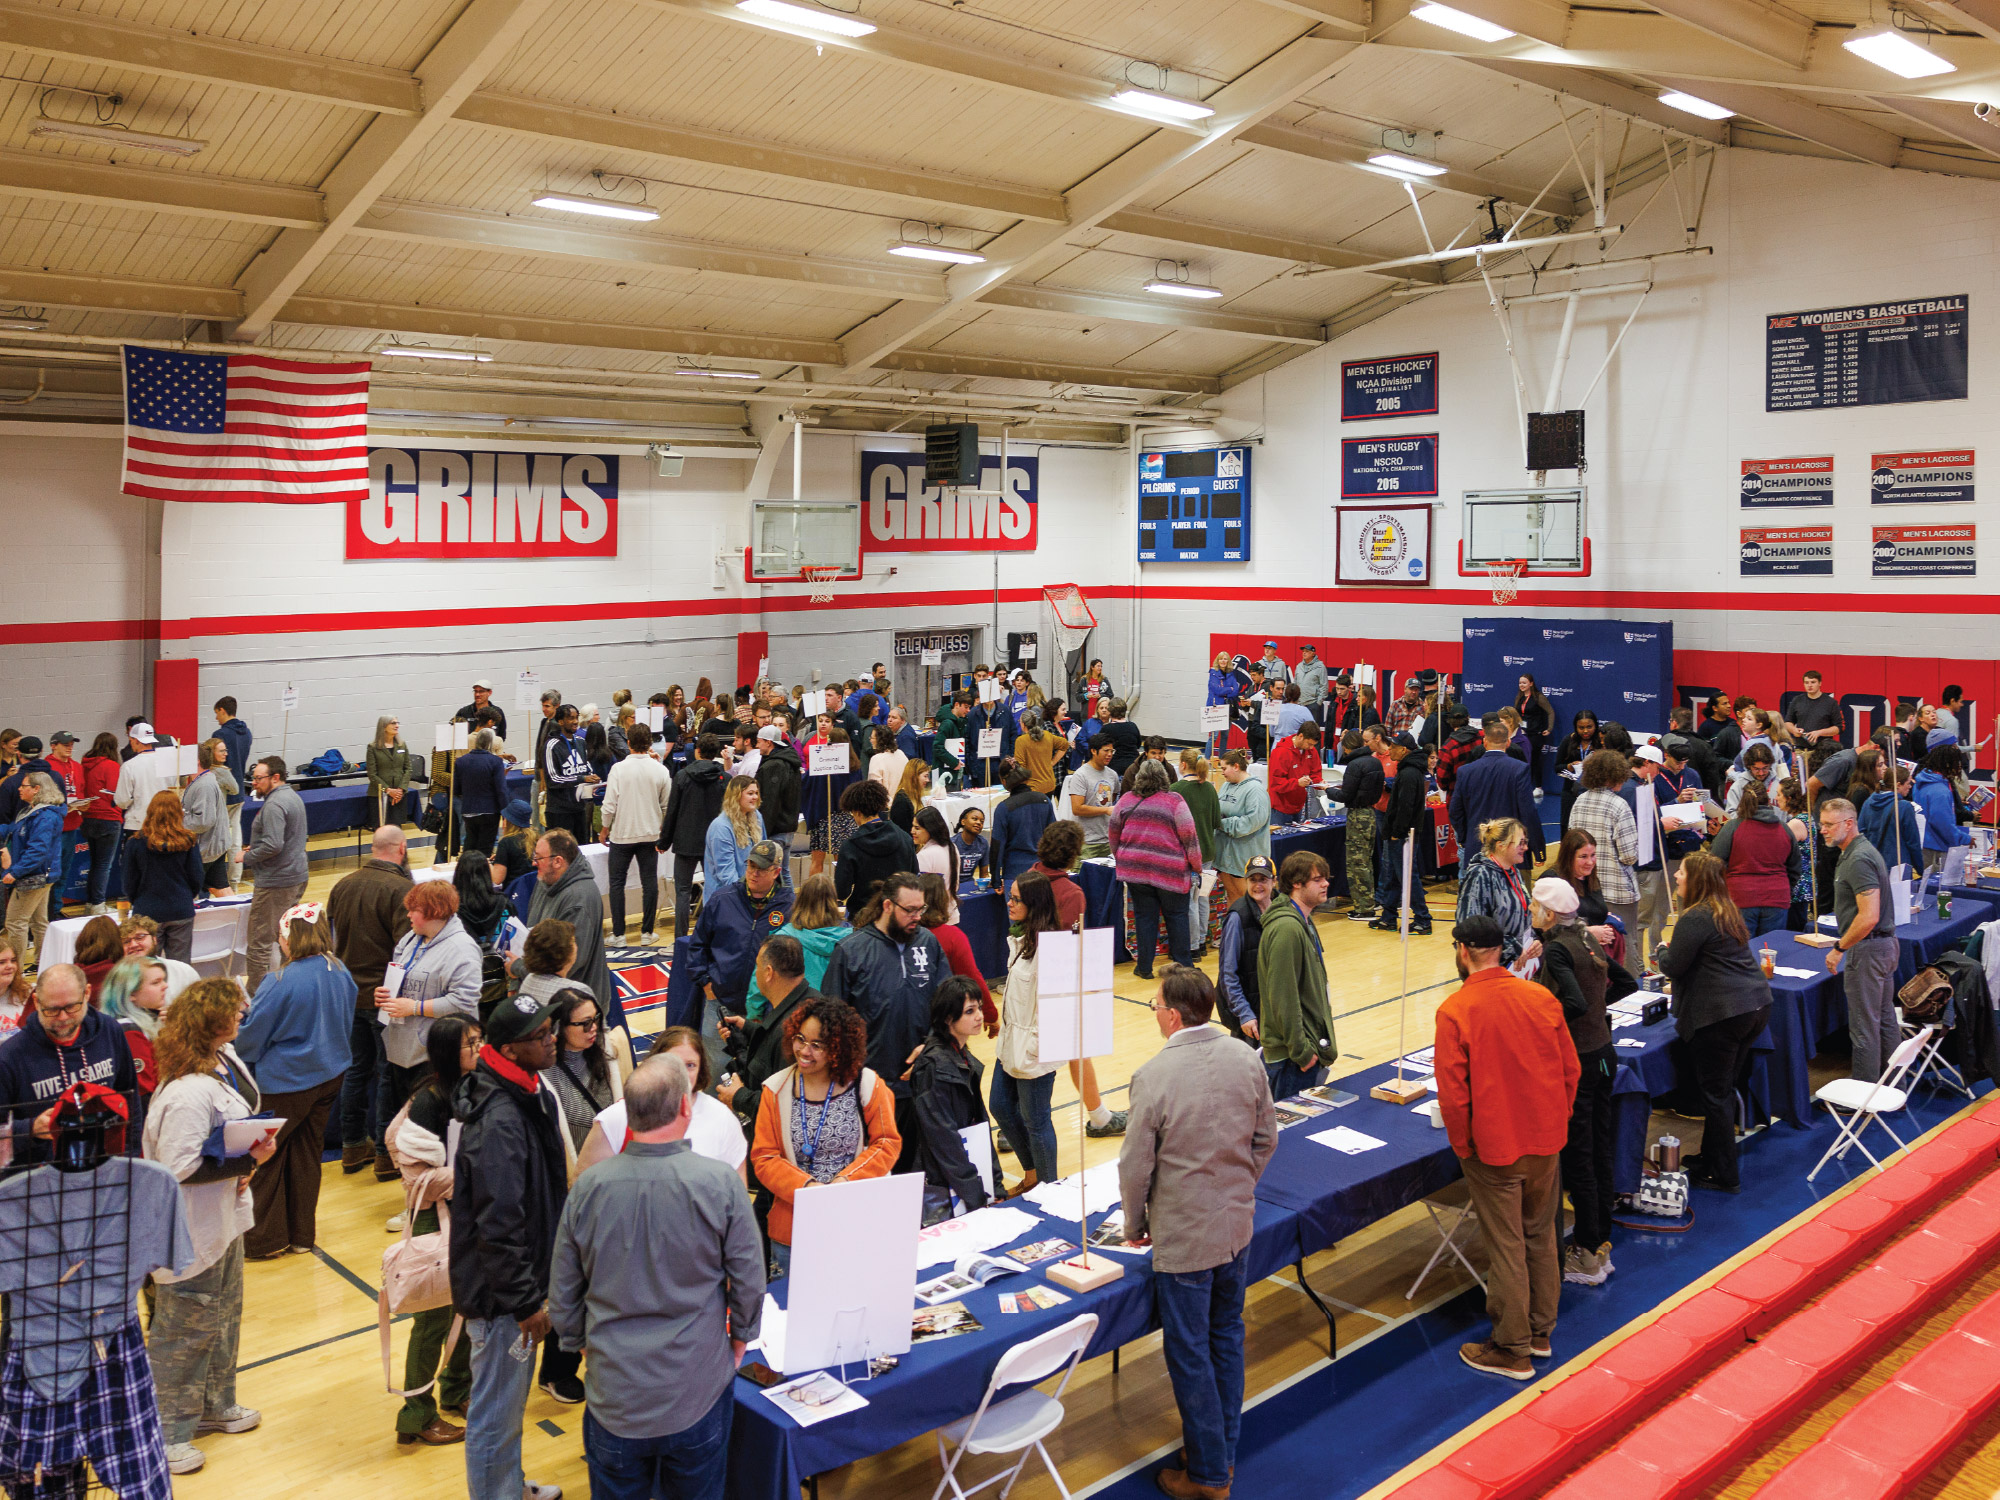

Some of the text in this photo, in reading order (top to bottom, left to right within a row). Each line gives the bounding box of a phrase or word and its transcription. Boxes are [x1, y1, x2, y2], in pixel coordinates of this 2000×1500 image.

[1801, 309, 1865, 325] WOMEN'S
[1869, 299, 1964, 318] BASKETBALL
[1824, 318, 1902, 331] 1,000 POINT SCORERS
[1347, 360, 1432, 377] MEN'S ICE HOCKEY
[1356, 374, 1422, 389] NCAA Division III
[1365, 384, 1412, 394] SEMIFINALIST
[1376, 397, 1401, 411] 2005
[1358, 441, 1420, 454] MEN'S RUGBY
[1374, 457, 1403, 467] NSCRO
[1927, 455, 1970, 463] LACROSSE
[1220, 465, 1241, 476] NEC
[1377, 477, 1399, 491] 2015
[1742, 478, 1832, 489] 2014 CHAMPIONS
[1872, 472, 1973, 485] 2016 CHAMPIONS
[1142, 482, 1176, 493] PILGRIMS
[1213, 479, 1240, 491] GUEST
[360, 448, 608, 544] GRIMS
[1180, 487, 1200, 495] PERIOD
[869, 463, 1031, 541] GRIMS
[1140, 522, 1156, 530] FOULS
[1171, 521, 1191, 529] PLAYER
[1223, 520, 1242, 528] FOULS
[1223, 551, 1241, 559] SCORE
[1742, 547, 1831, 557] 2001 CHAMPIONS
[1873, 546, 1974, 557] 2002 CHAMPIONS
[1367, 565, 1398, 575] INTEGRITY
[563, 764, 587, 776] adidas
[32, 1075, 64, 1100] VIVE
[79, 1057, 115, 1083] SARRE
